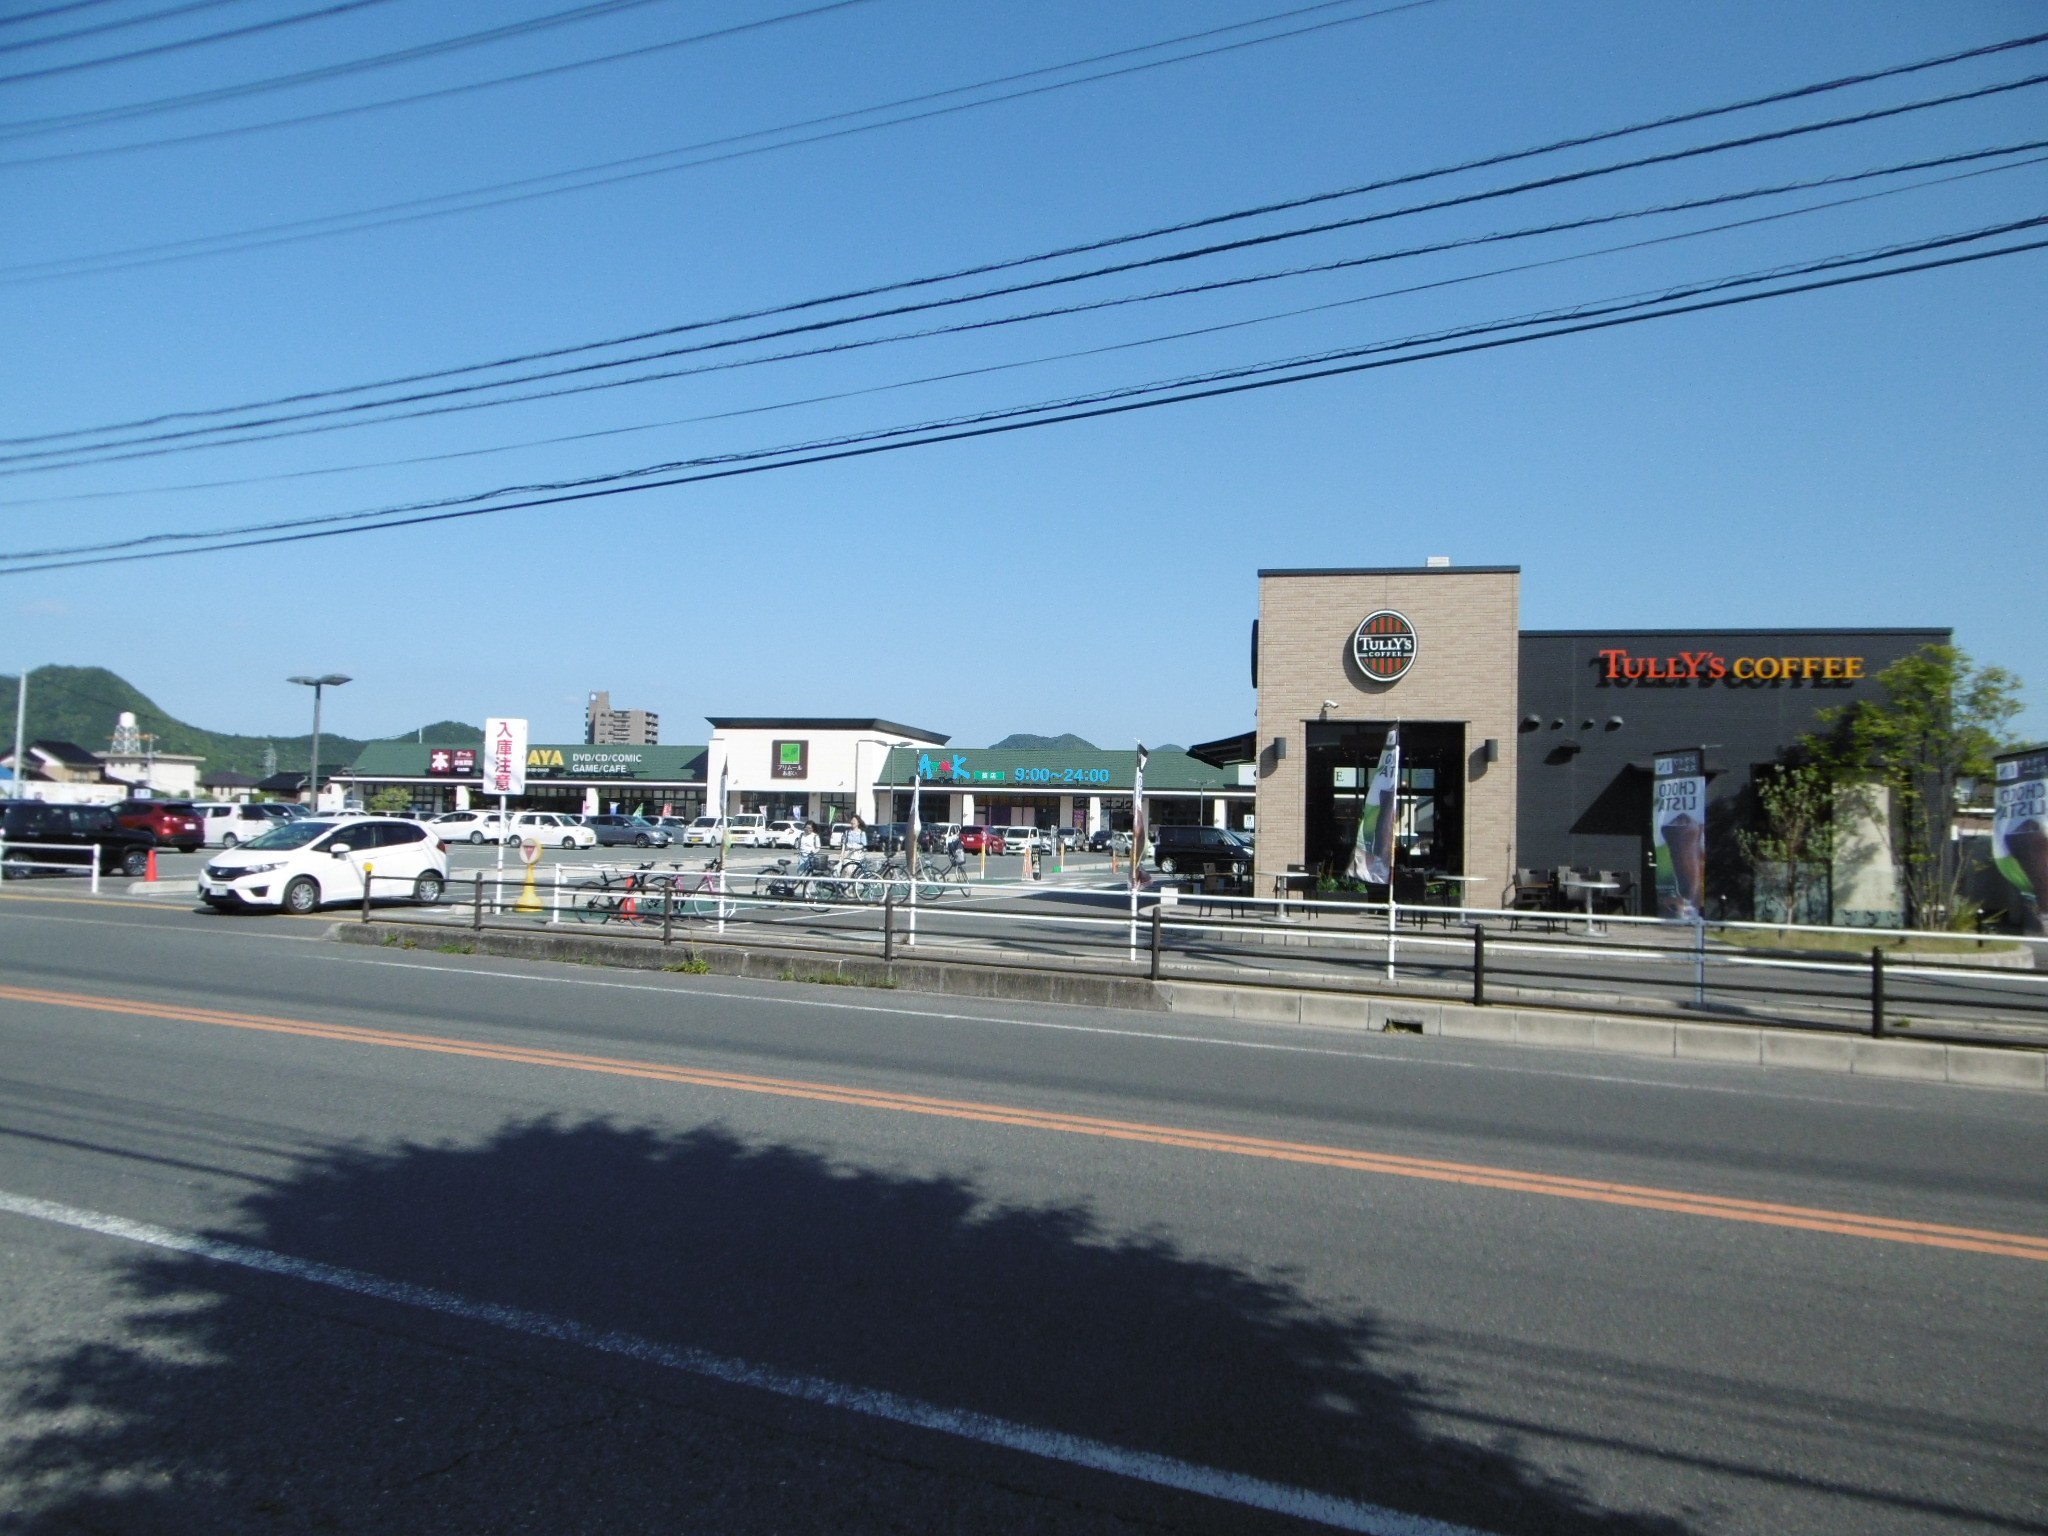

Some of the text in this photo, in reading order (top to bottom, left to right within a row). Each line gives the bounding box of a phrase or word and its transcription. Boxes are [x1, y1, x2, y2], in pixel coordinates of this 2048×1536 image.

[1358, 637, 1412, 651] TULLY'S
[1599, 649, 1866, 680] TULLY'S COFFEE
[431, 751, 449, 771] 本
[494, 721, 513, 791] 入庫注意
[572, 752, 642, 763] DVD/CD/COMIC
[572, 764, 628, 773] GAME/CAFE
